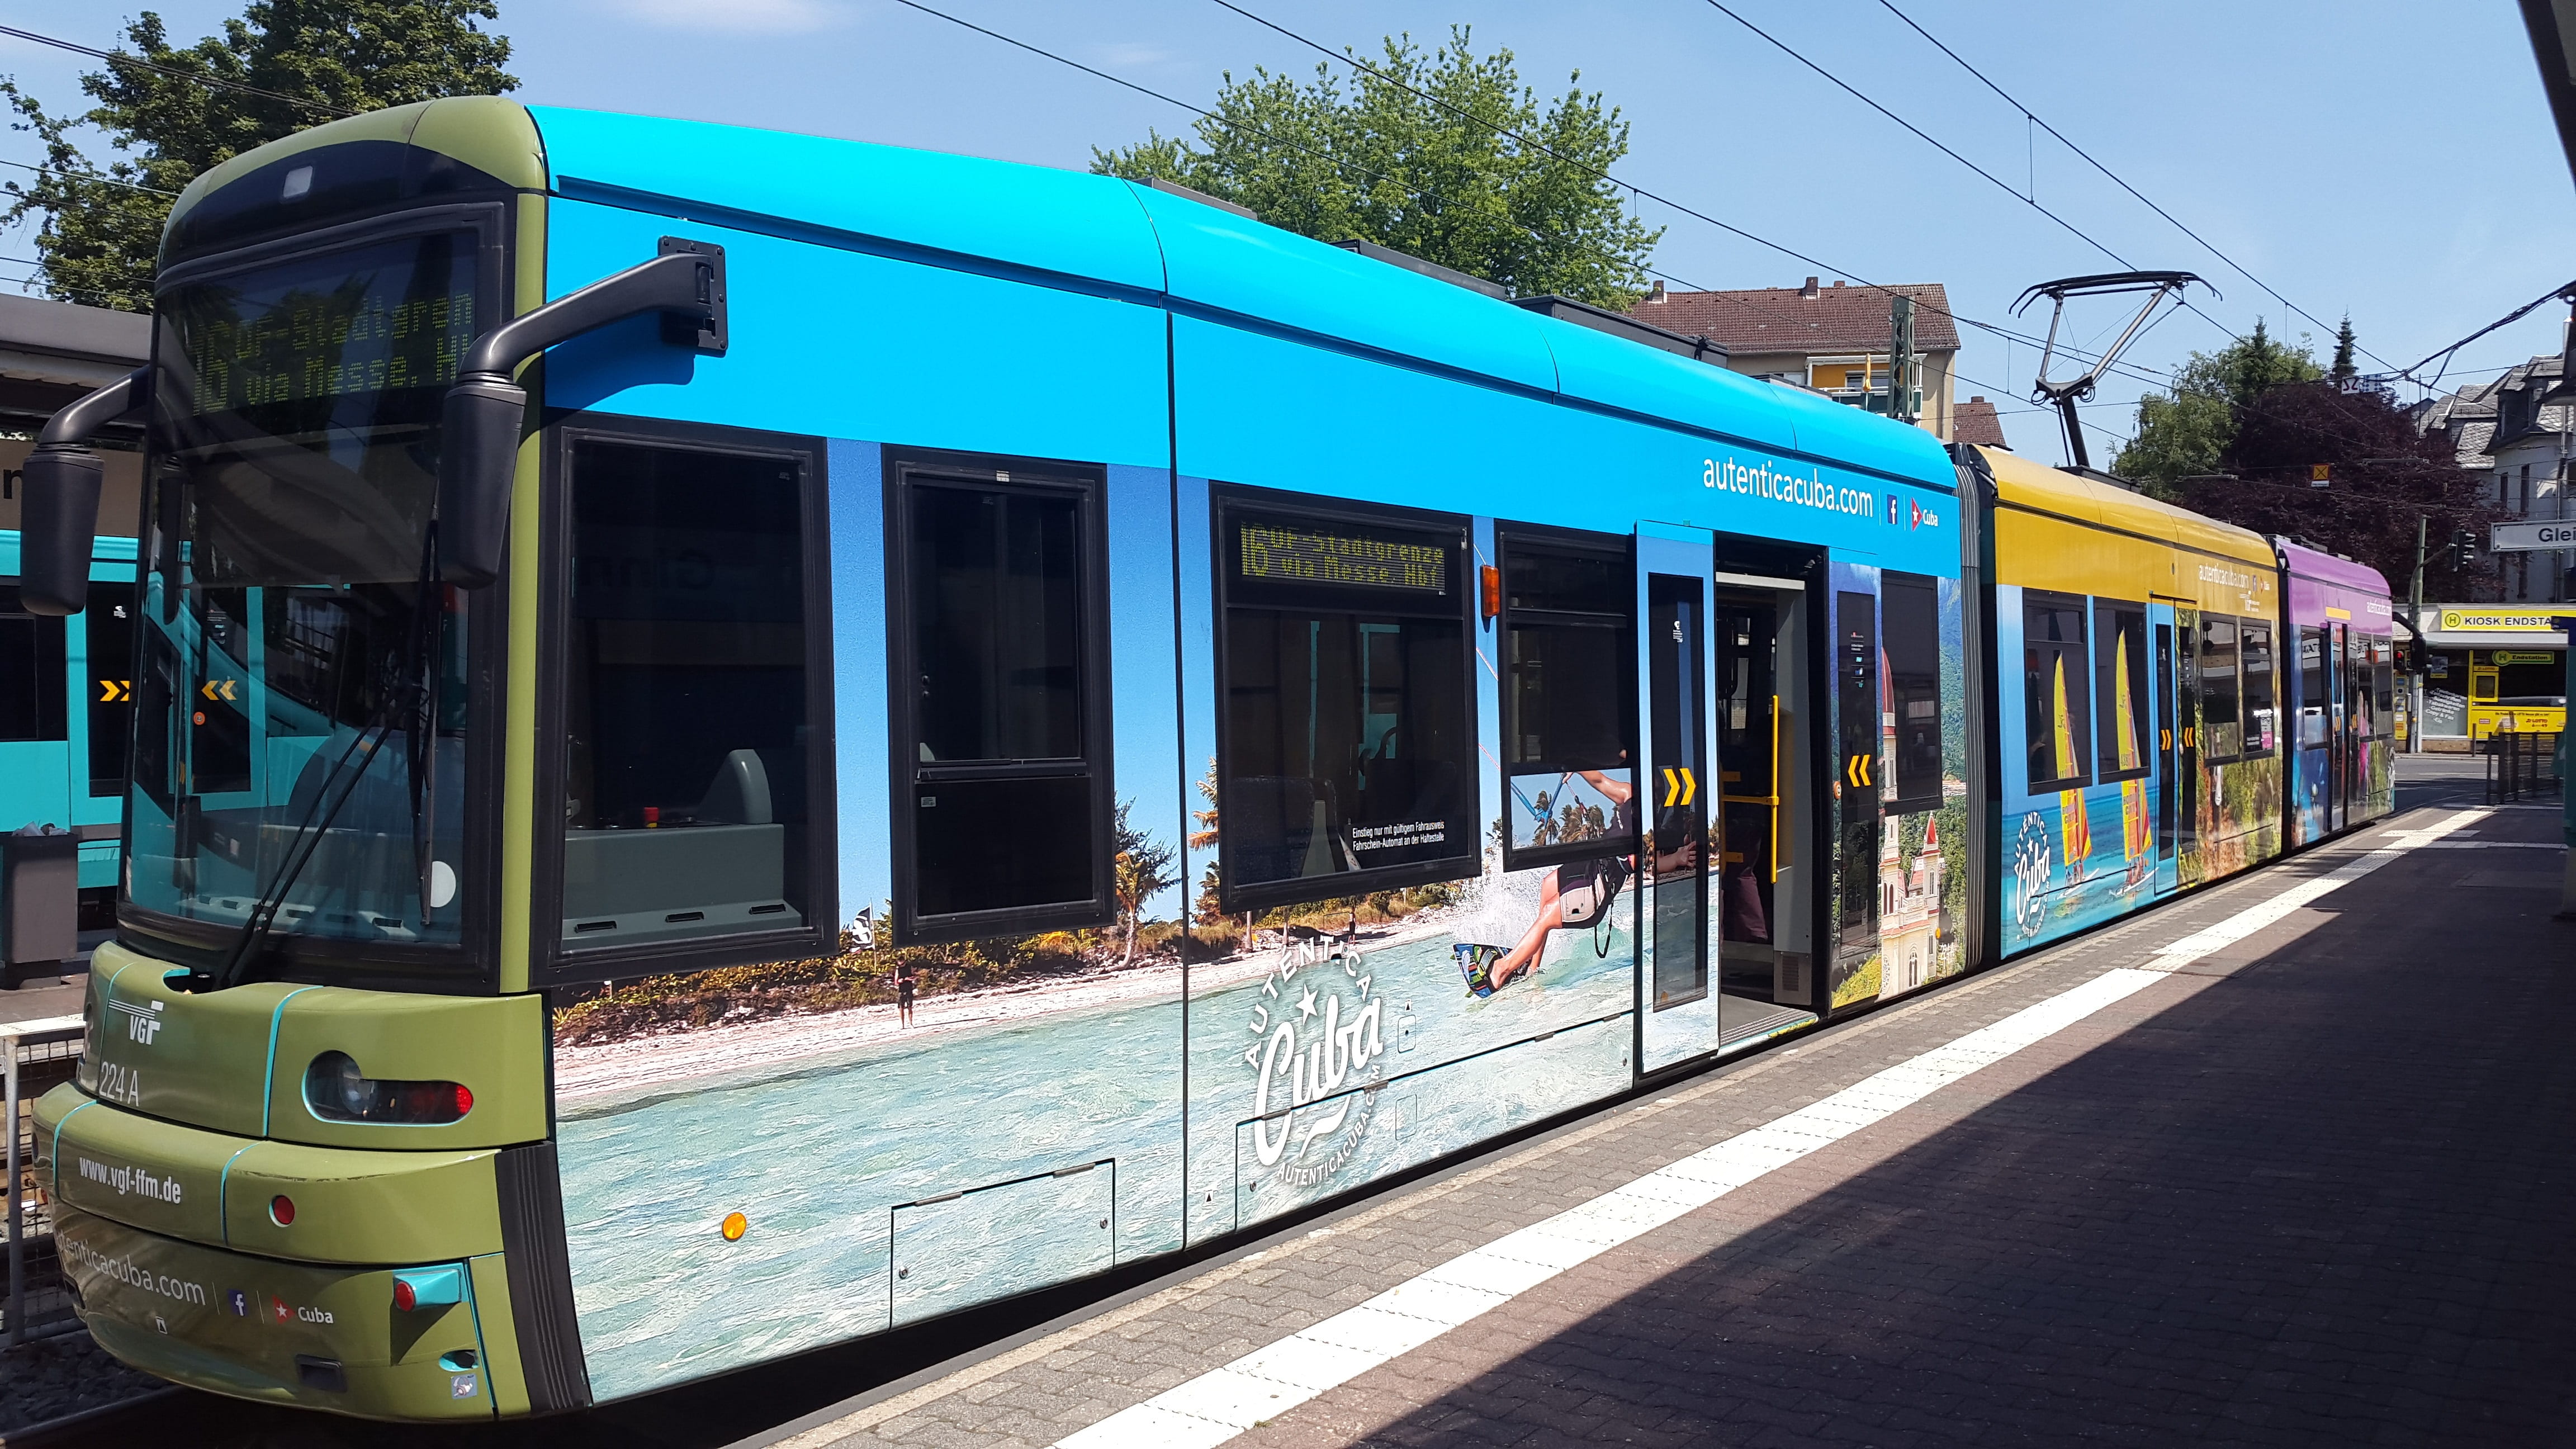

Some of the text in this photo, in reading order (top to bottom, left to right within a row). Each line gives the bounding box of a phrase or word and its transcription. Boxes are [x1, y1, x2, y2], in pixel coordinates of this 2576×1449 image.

[235, 293, 472, 359] OF-Stadtgren
[246, 362, 290, 405] via
[305, 355, 418, 399] Messe,
[1703, 456, 1874, 518] autenticacuba.com
[1922, 508, 1939, 527] Cuba
[1240, 521, 1268, 576] 16
[2538, 527, 2576, 542] Glei
[1282, 553, 1315, 577] via
[1405, 564, 1437, 588] Hbf
[2465, 617, 2501, 626] KIOSK
[2505, 617, 2551, 626] ENDSTA
[1352, 820, 1445, 839] Einstieg nur mit gültigem Fahrausweis
[1353, 837, 1403, 851] Fahrschein-Automat
[1411, 835, 1419, 844] der
[1420, 832, 1445, 843] Haltestelle
[2016, 842, 2050, 925] Cuba
[129, 1014, 161, 1046] VGF
[99, 1060, 140, 1107] 224 A
[1254, 994, 1384, 1166] Cuba
[79, 1156, 182, 1204] www.vgf-ffm.de
[56, 1229, 206, 1306] utenticacuba.com
[297, 1305, 334, 1324] Cuba
